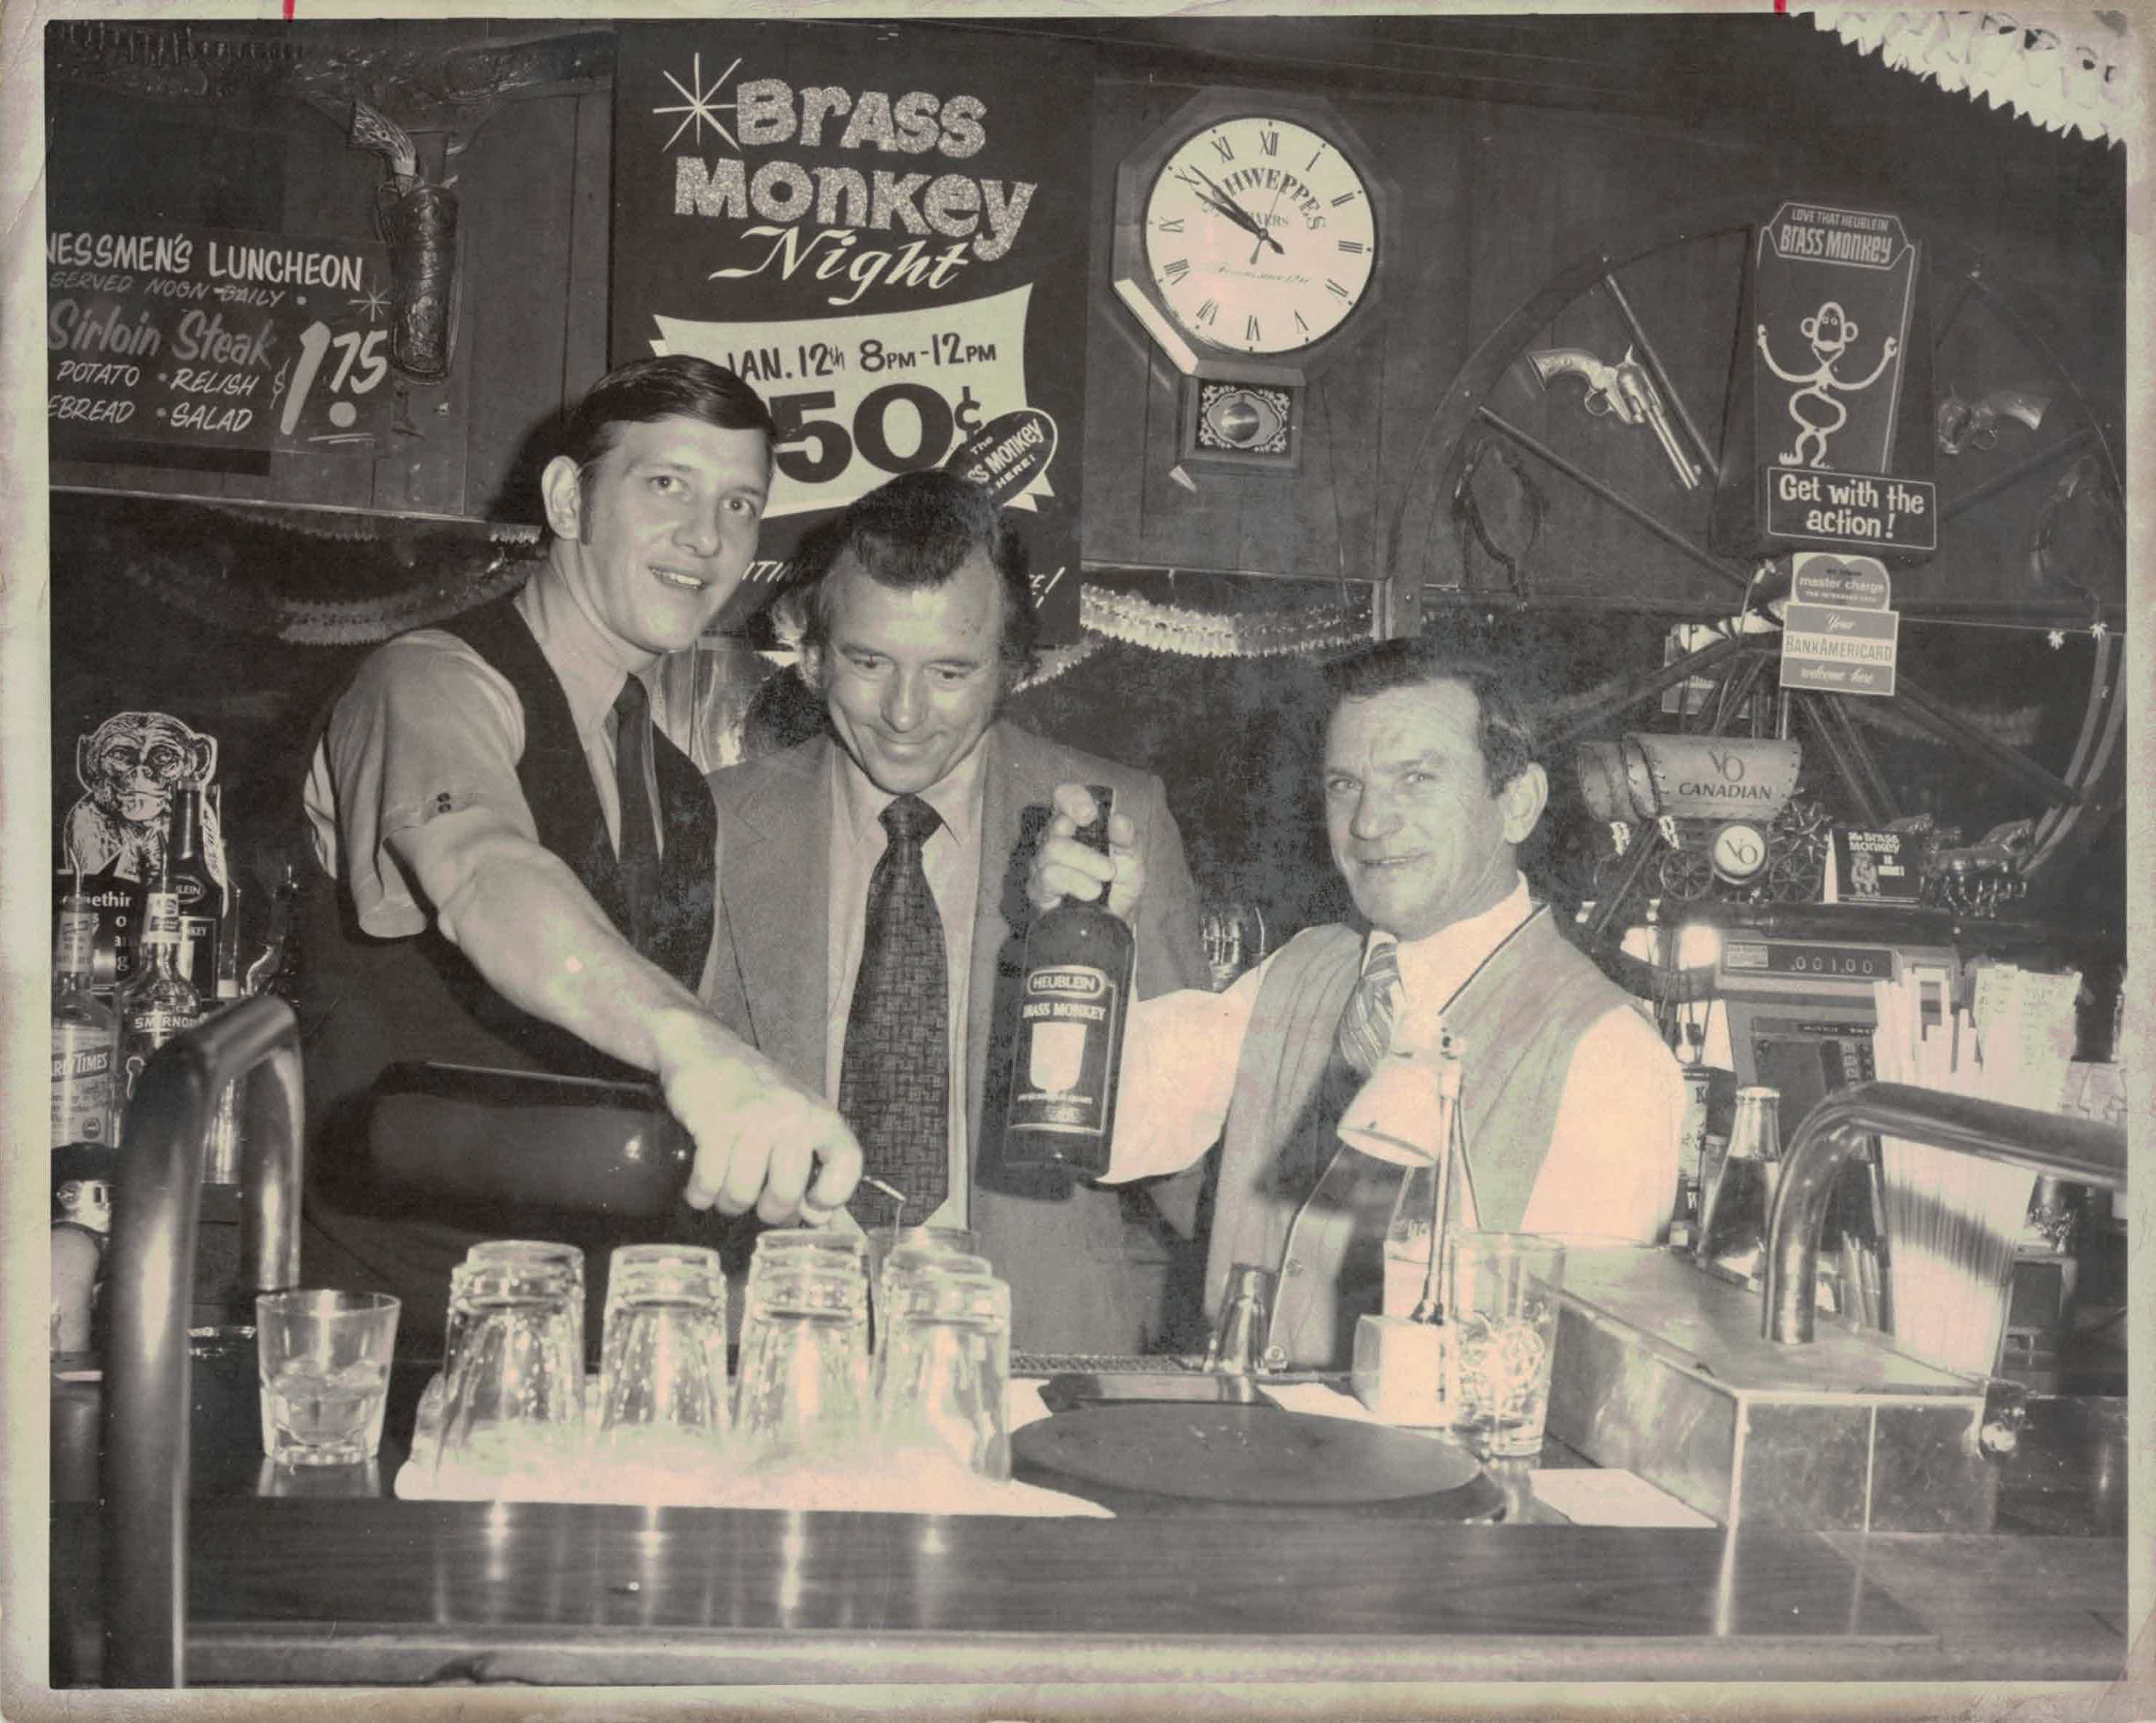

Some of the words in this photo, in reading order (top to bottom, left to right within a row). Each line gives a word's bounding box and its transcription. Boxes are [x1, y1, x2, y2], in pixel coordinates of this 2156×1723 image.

[1211, 136, 1235, 164] XI
[1259, 130, 1279, 156] XII
[1330, 192, 1355, 208] II
[1792, 209, 1814, 222] LOVE
[1819, 212, 1840, 225] THAT
[1338, 240, 1363, 254] III
[210, 242, 362, 292] LUNCHEON
[708, 227, 969, 305] Night
[50, 271, 133, 292] SERVED
[144, 278, 209, 300] NOON
[47, 299, 162, 356] Sirloin
[172, 309, 278, 370] Steak
[56, 360, 141, 387] POTATO
[170, 367, 260, 396] RELISH
[171, 402, 252, 431] SALAD
[1778, 474, 1821, 501] Get
[1827, 478, 1878, 508] with
[1887, 484, 1924, 514] the
[1679, 782, 1772, 800] CANADIAN
[1033, 975, 1095, 991] HEUBLEIN
[74, 1052, 108, 1074] TIMES
